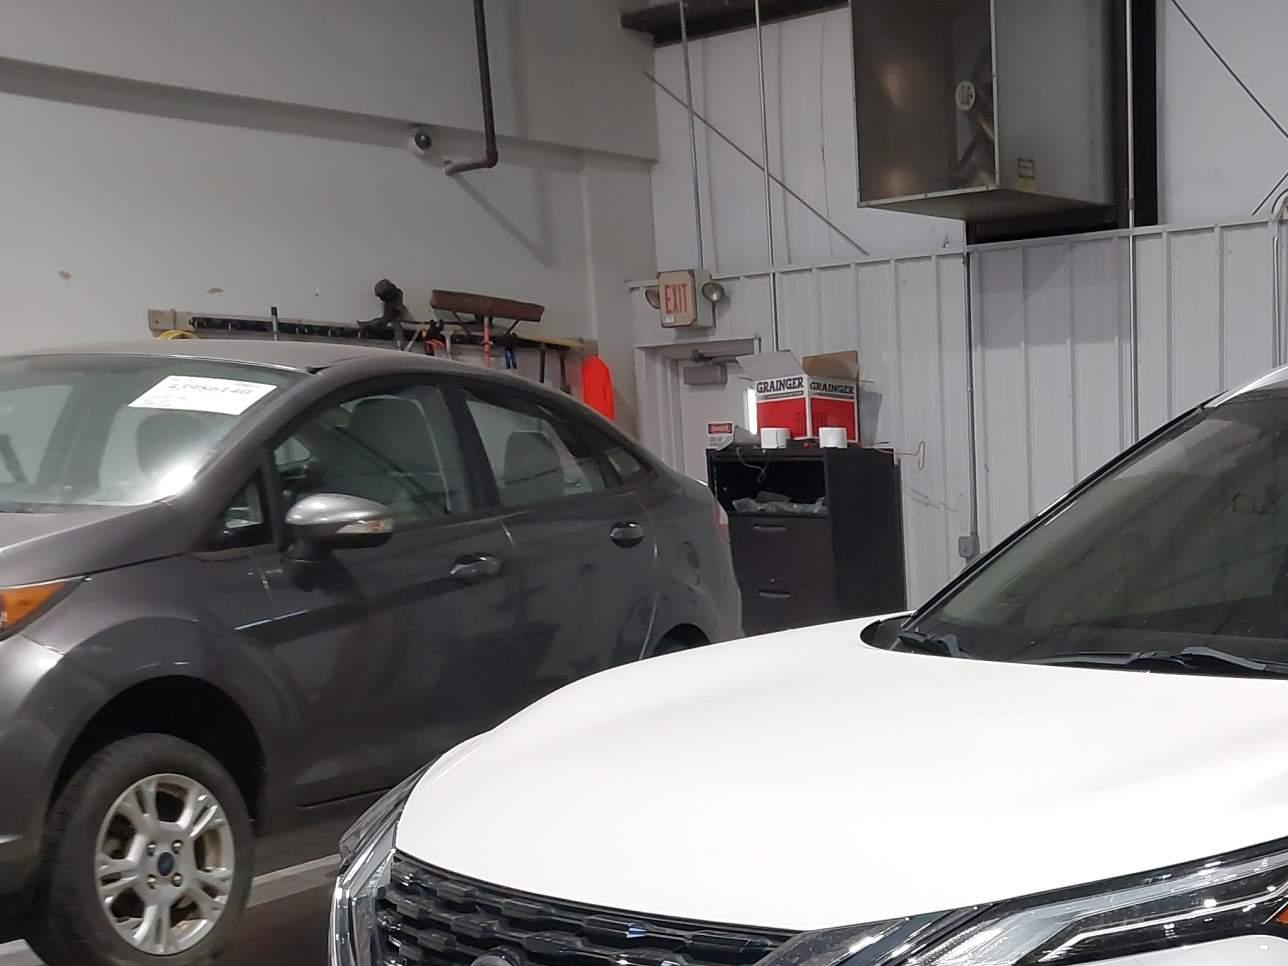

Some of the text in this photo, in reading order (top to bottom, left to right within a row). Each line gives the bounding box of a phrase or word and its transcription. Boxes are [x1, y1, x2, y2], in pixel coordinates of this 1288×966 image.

[664, 283, 688, 314] EXIT
[756, 376, 804, 393] GRAINGER
[809, 381, 855, 395] GRAINGER
